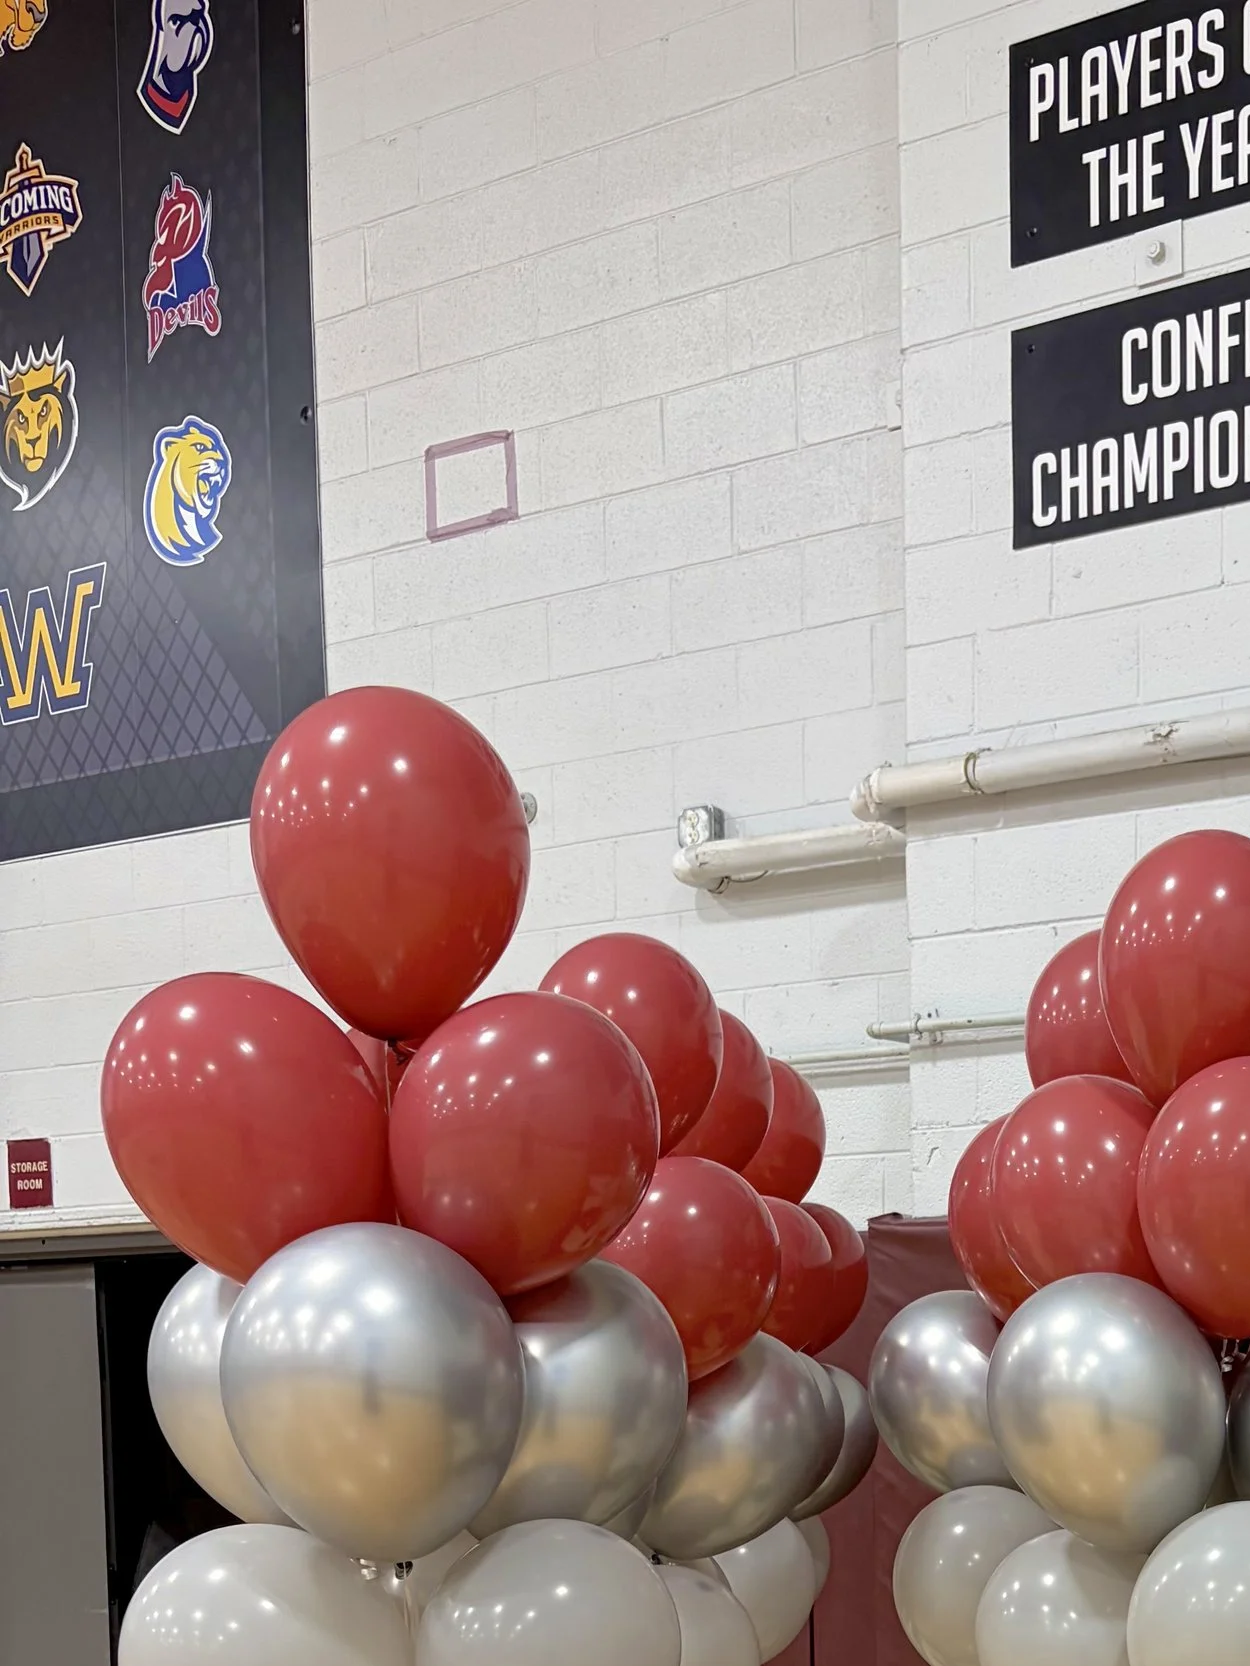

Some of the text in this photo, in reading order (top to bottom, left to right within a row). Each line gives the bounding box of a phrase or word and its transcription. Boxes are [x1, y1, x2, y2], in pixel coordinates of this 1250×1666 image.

[1029, 8, 1225, 142] PLAYERS
[1082, 130, 1165, 228] THE
[0, 184, 74, 226] COMING
[10, 1161, 48, 1173] STORAGE
[17, 1178, 43, 1190] ROOM
